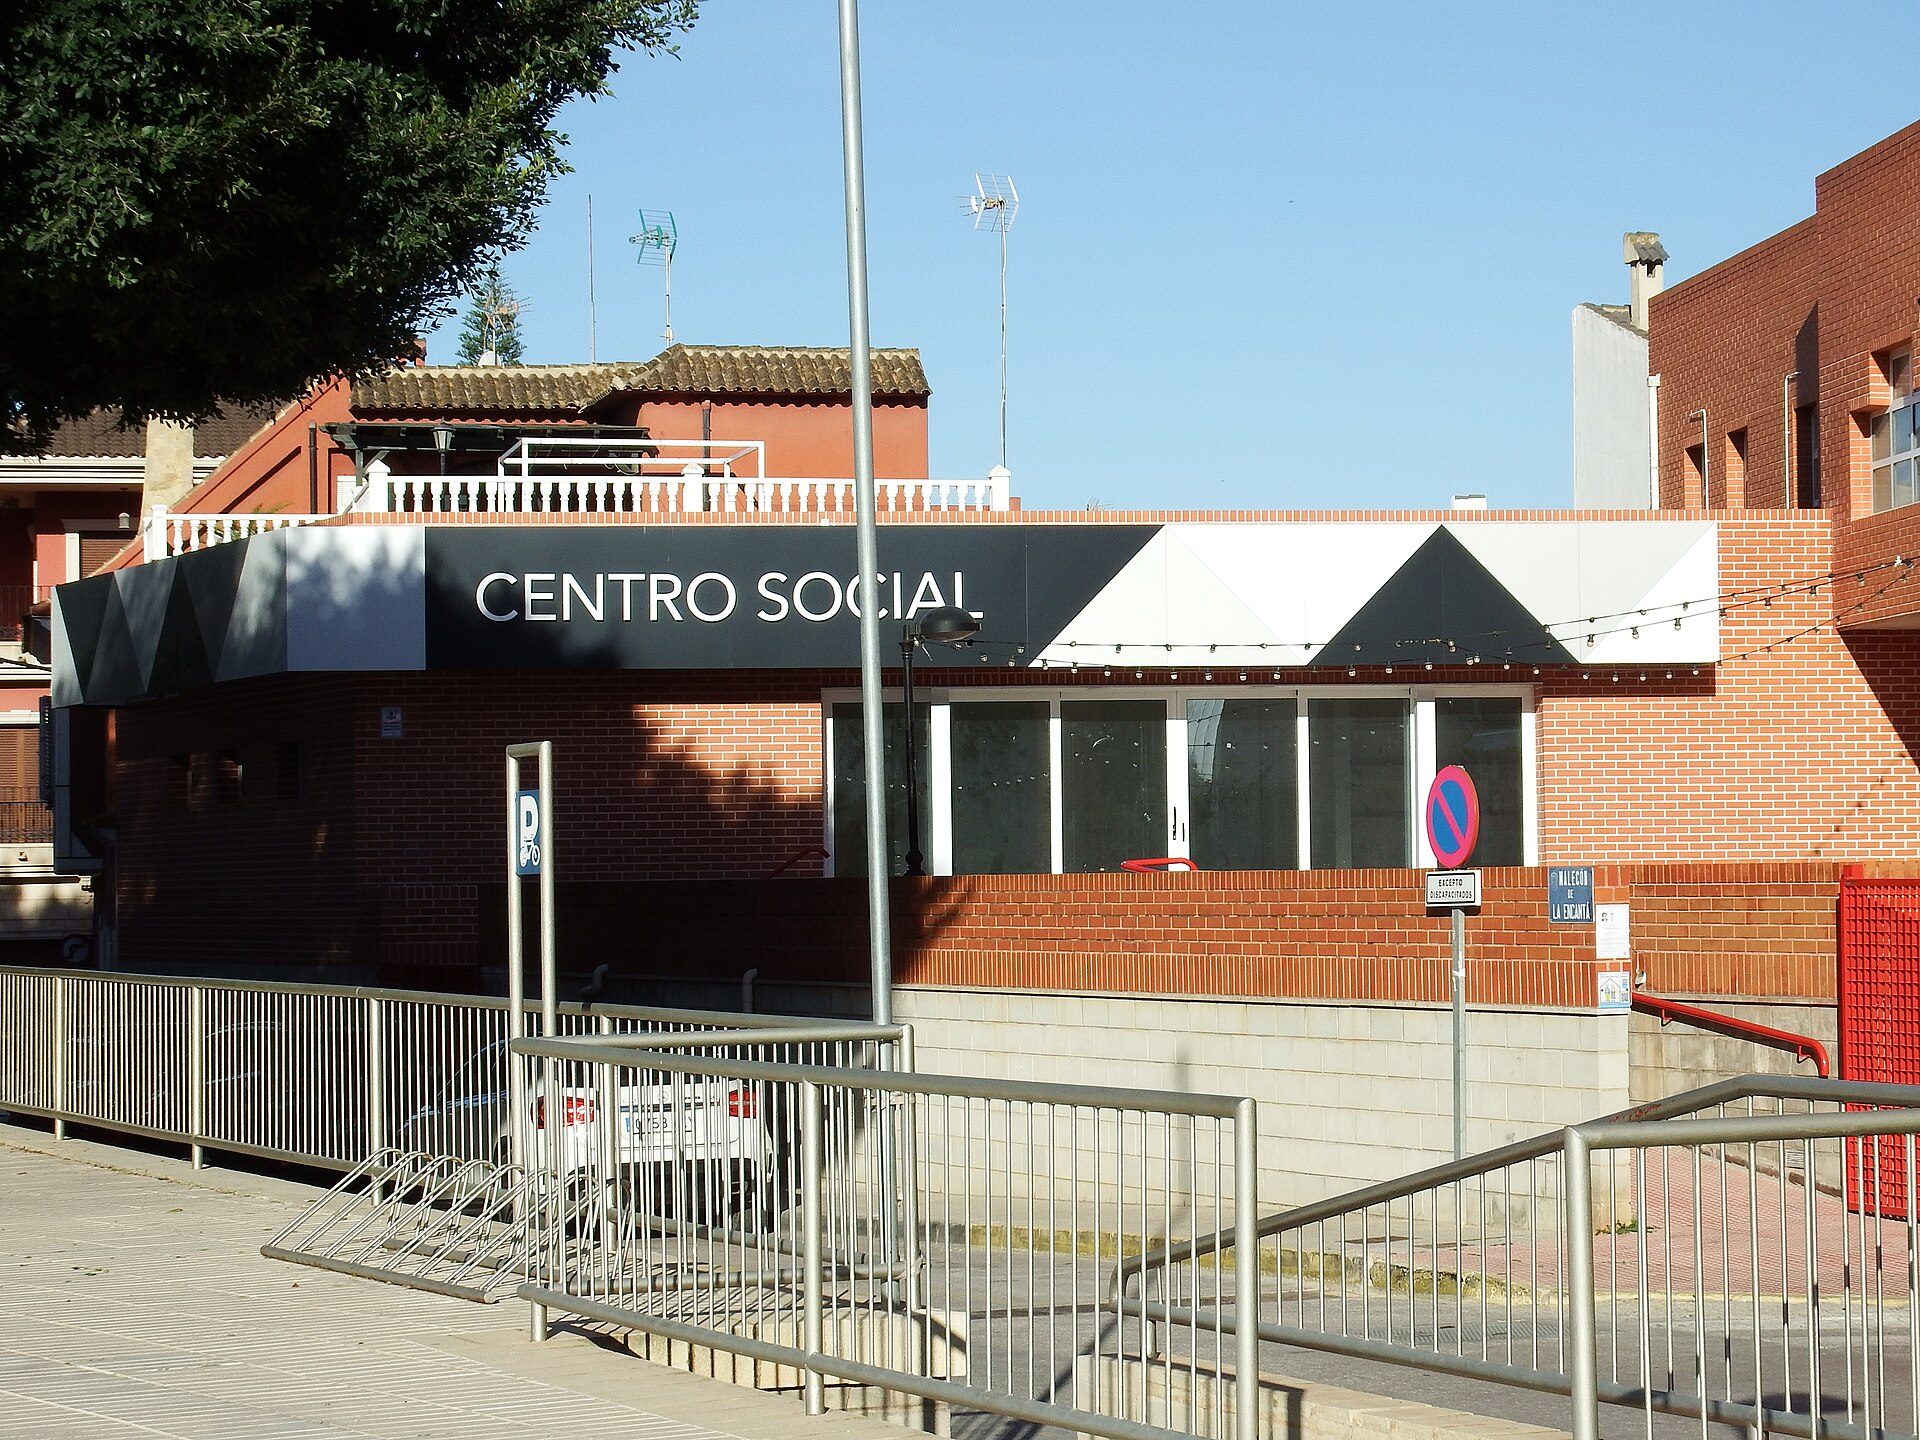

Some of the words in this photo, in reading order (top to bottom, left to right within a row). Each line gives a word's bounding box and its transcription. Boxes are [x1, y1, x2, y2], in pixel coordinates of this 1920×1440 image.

[475, 571, 737, 623] CENTRO
[756, 571, 984, 623] SOCIAL
[1438, 878, 1463, 887] EXCEPTO
[1558, 868, 1588, 886] MALECÓN
[1430, 890, 1472, 899] DISCAPACITADOS
[1567, 888, 1574, 899] DE
[1552, 903, 1561, 920] LA
